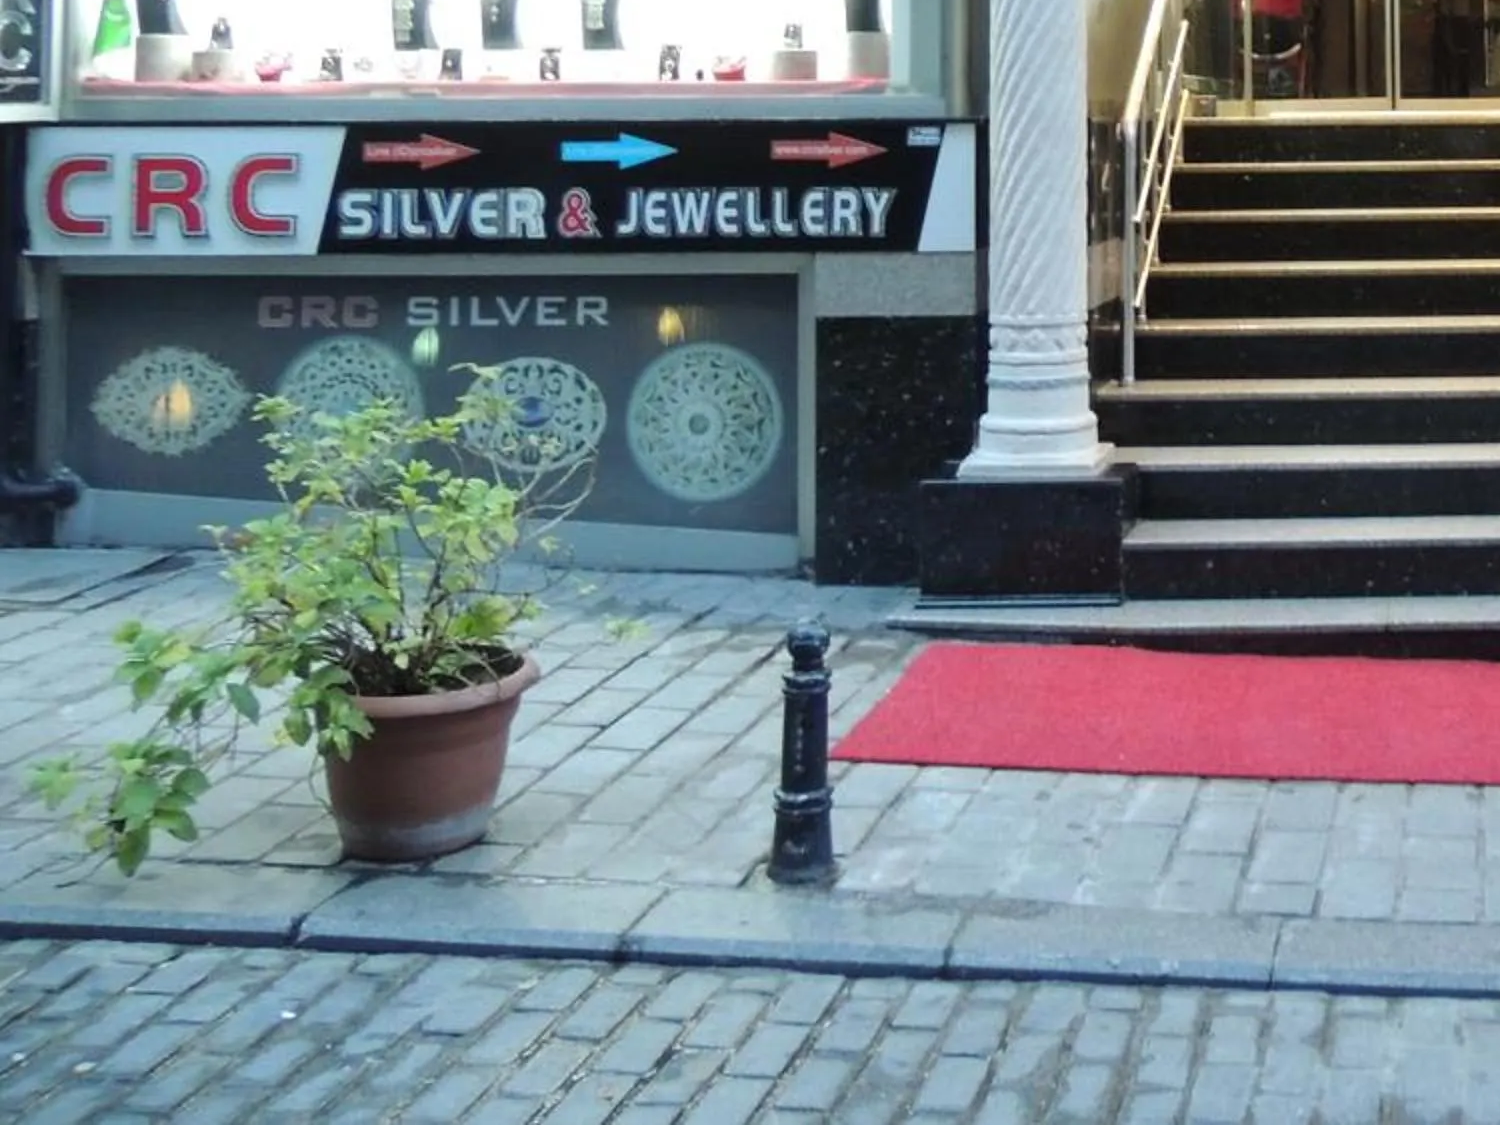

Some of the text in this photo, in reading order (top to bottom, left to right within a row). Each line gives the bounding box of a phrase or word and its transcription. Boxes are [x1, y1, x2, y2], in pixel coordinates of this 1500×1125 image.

[44, 154, 896, 240] CRC SILVER & JEWELLERY
[258, 295, 609, 329] CRC SILVER
